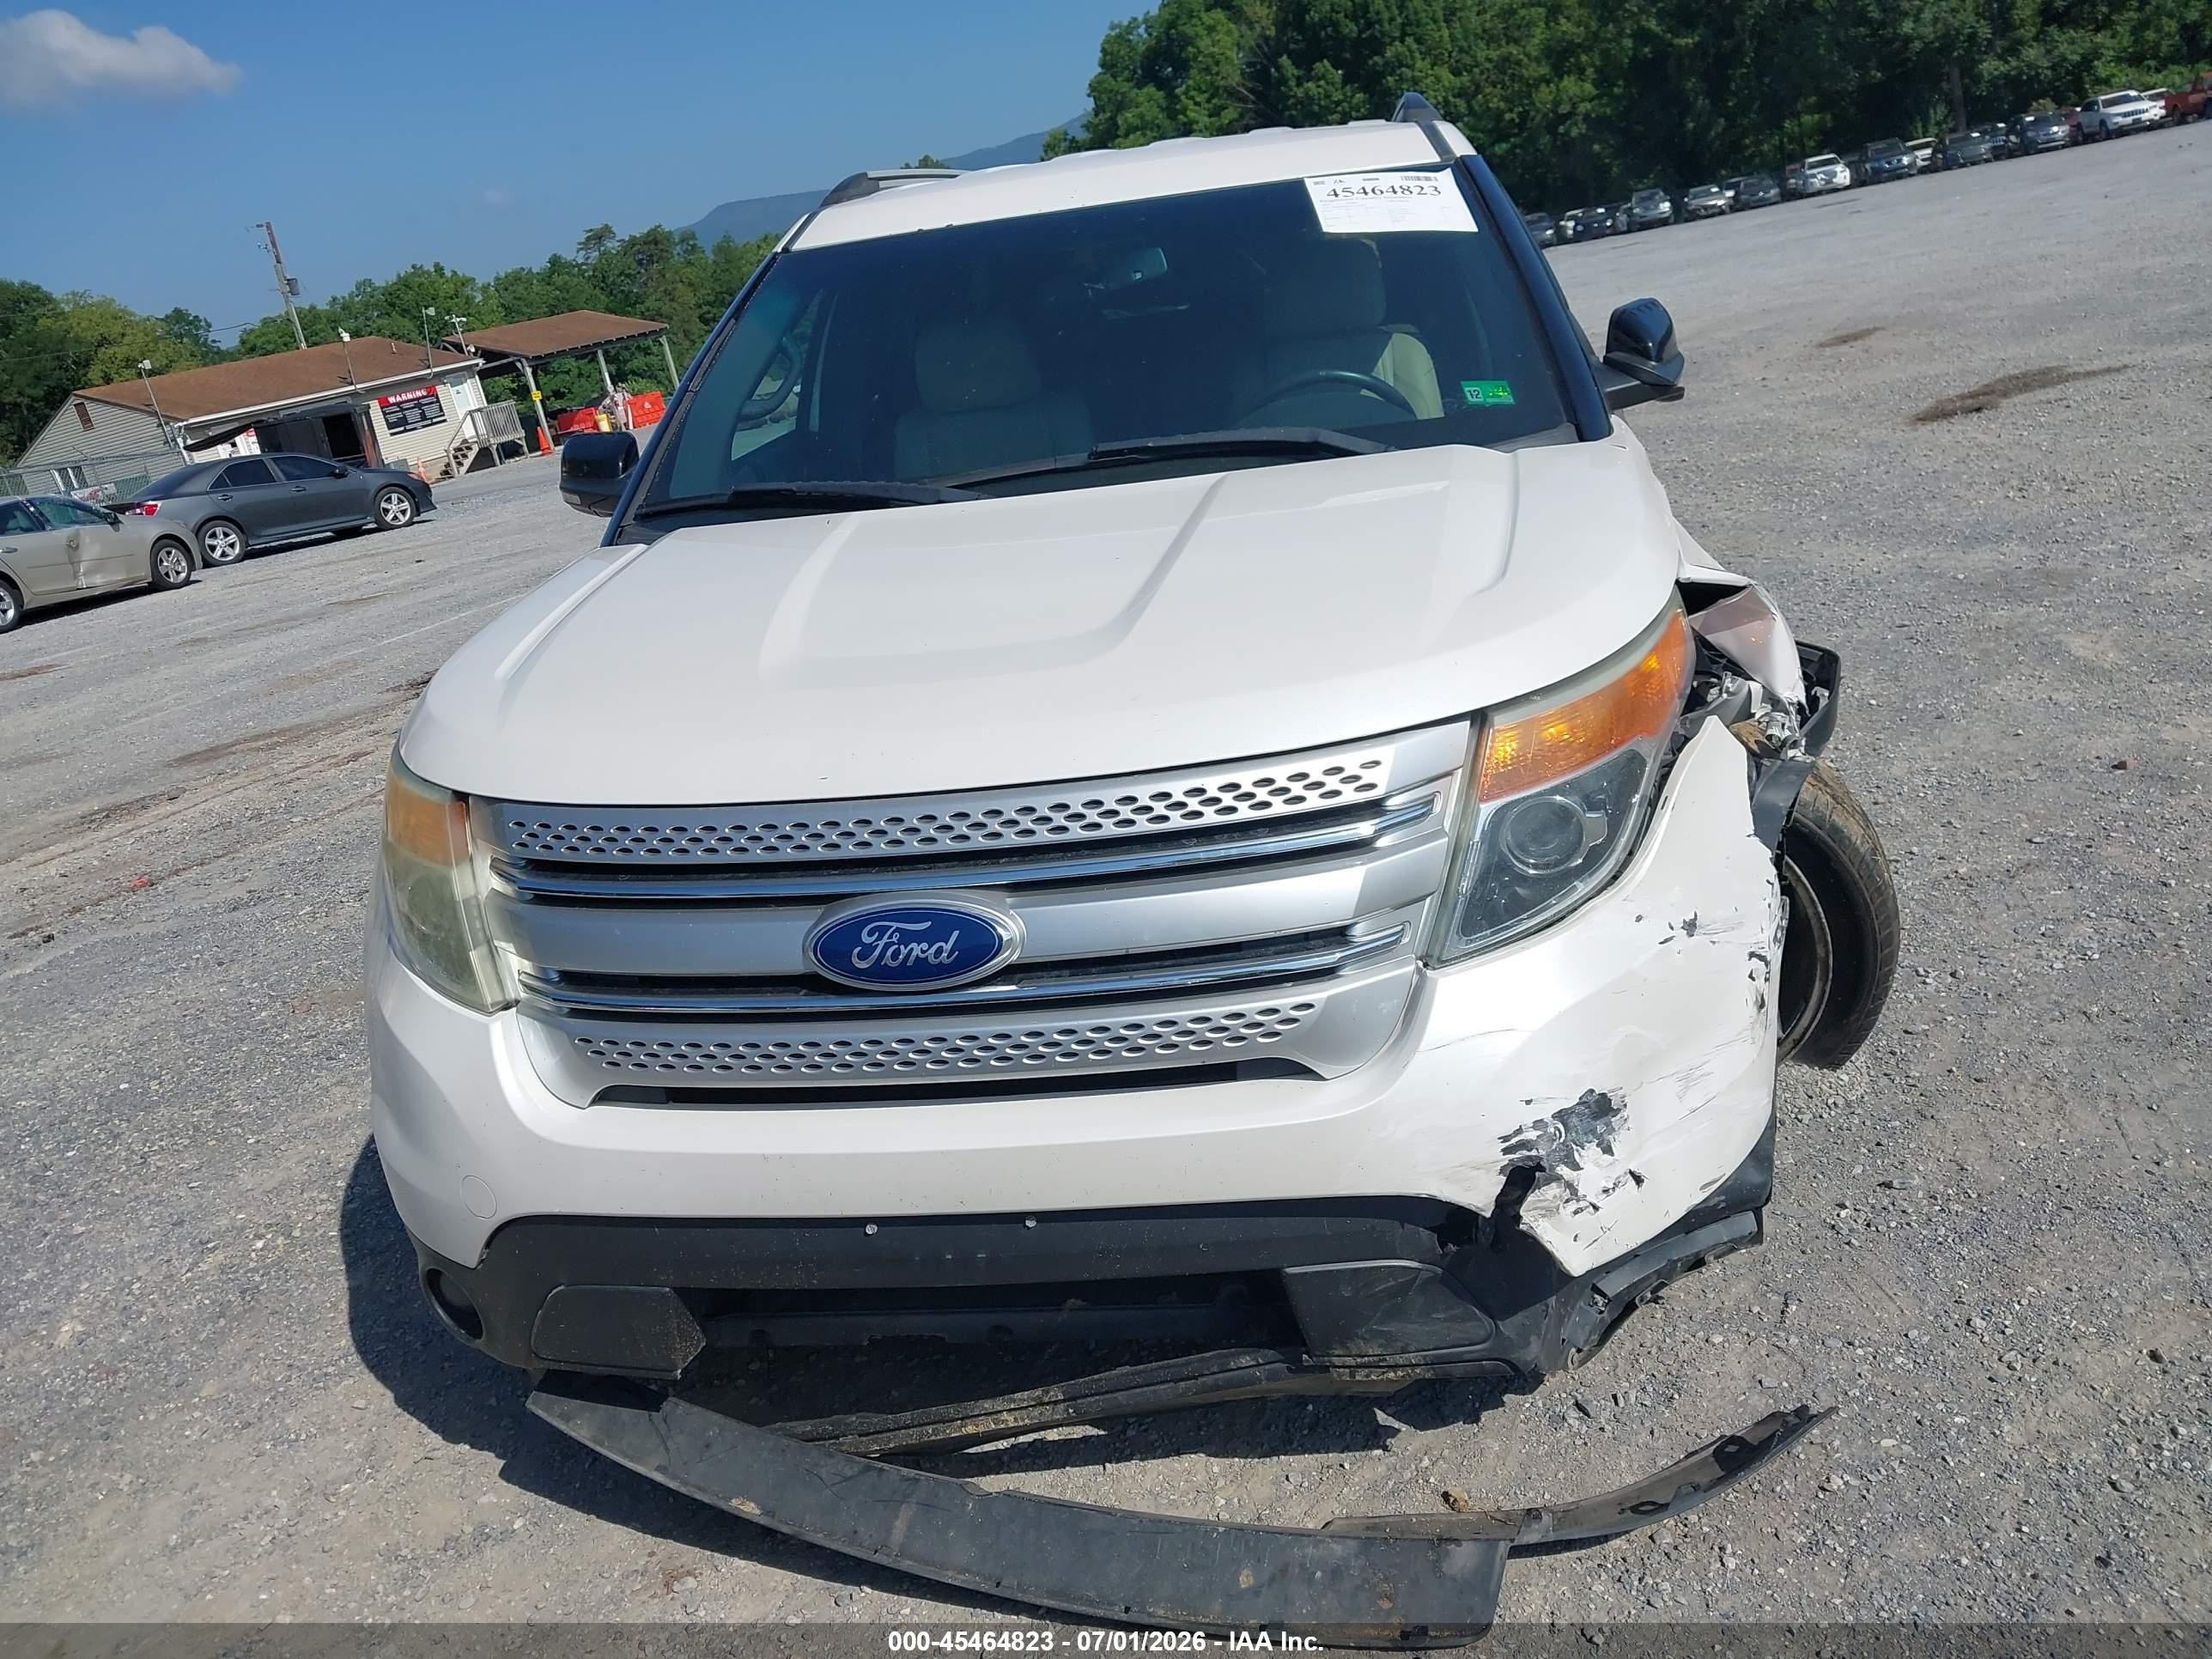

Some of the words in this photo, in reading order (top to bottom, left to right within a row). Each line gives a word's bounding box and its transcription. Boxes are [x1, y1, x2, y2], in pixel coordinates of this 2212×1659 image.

[1326, 184, 1442, 198] 45464823
[386, 388, 428, 404] WARNING
[851, 921, 960, 969] Ford
